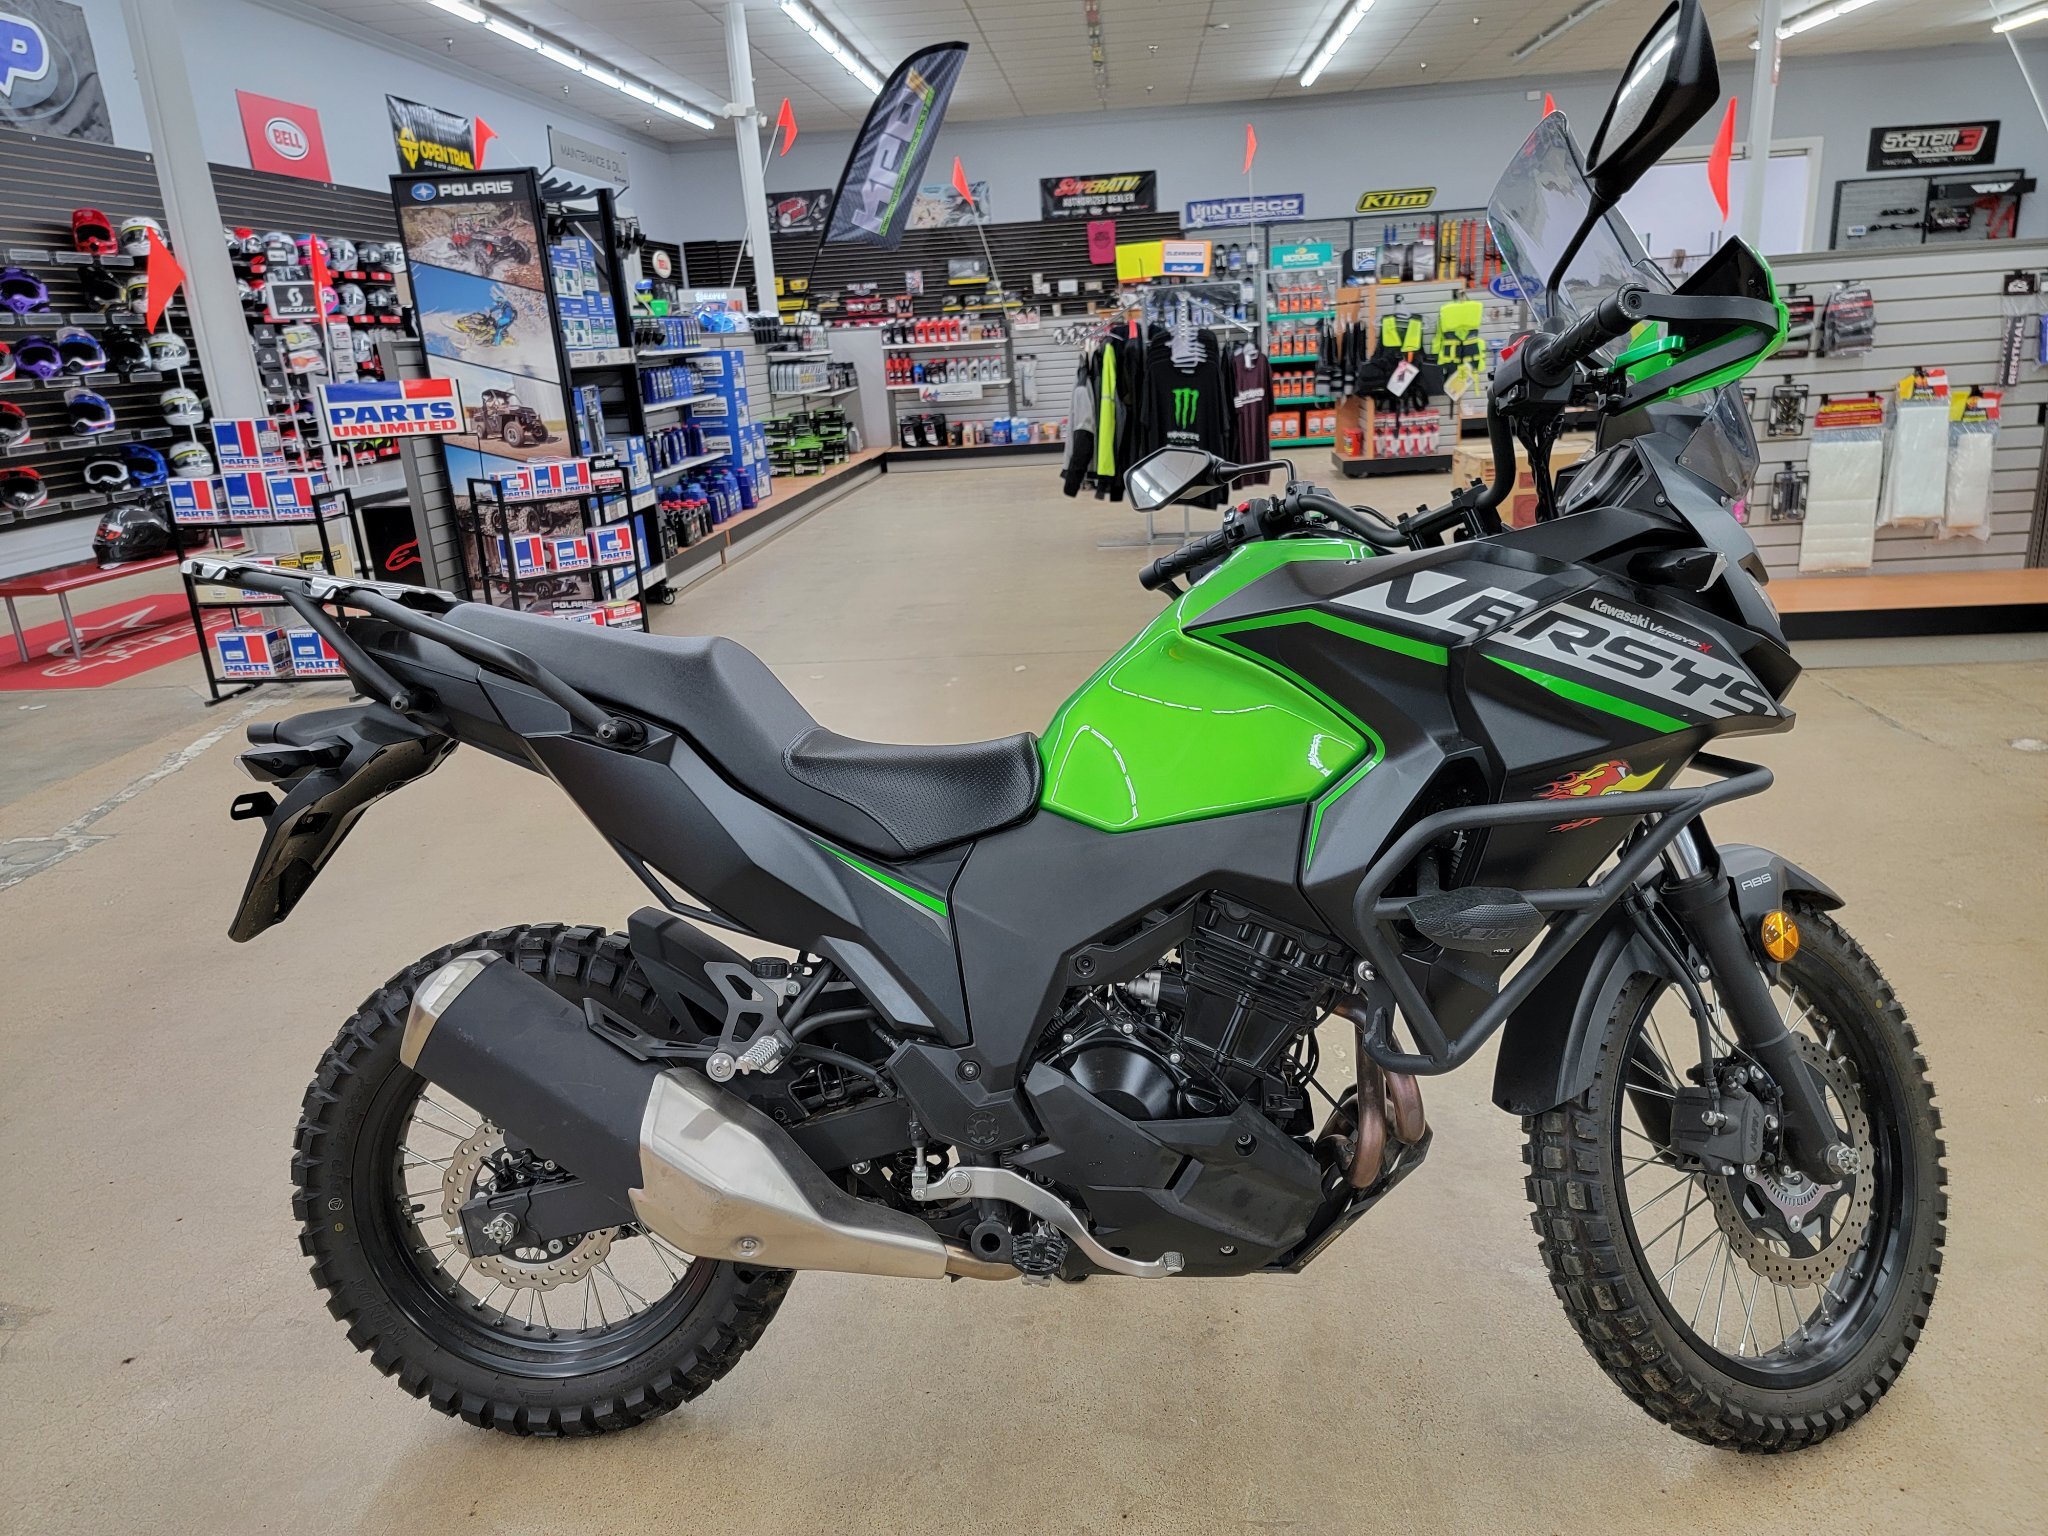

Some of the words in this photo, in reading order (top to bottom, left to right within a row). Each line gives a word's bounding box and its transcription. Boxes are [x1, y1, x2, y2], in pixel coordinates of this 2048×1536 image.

[272, 129, 303, 150] BELL
[1882, 130, 1959, 148] SYSTEM
[1952, 128, 1984, 152] 3
[439, 181, 513, 197] POLARIS
[329, 402, 455, 425] PARTS
[333, 419, 457, 438] UNLIMITED
[276, 507, 315, 515] PARTS
[560, 559, 589, 567] PARTS
[600, 550, 632, 559] PARTS
[520, 566, 545, 574] PARTS
[1589, 597, 1651, 629] Kawasaki
[1385, 570, 1778, 719] VERSYS
[224, 664, 270, 672] PARTS
[1741, 873, 1772, 891] ABS
